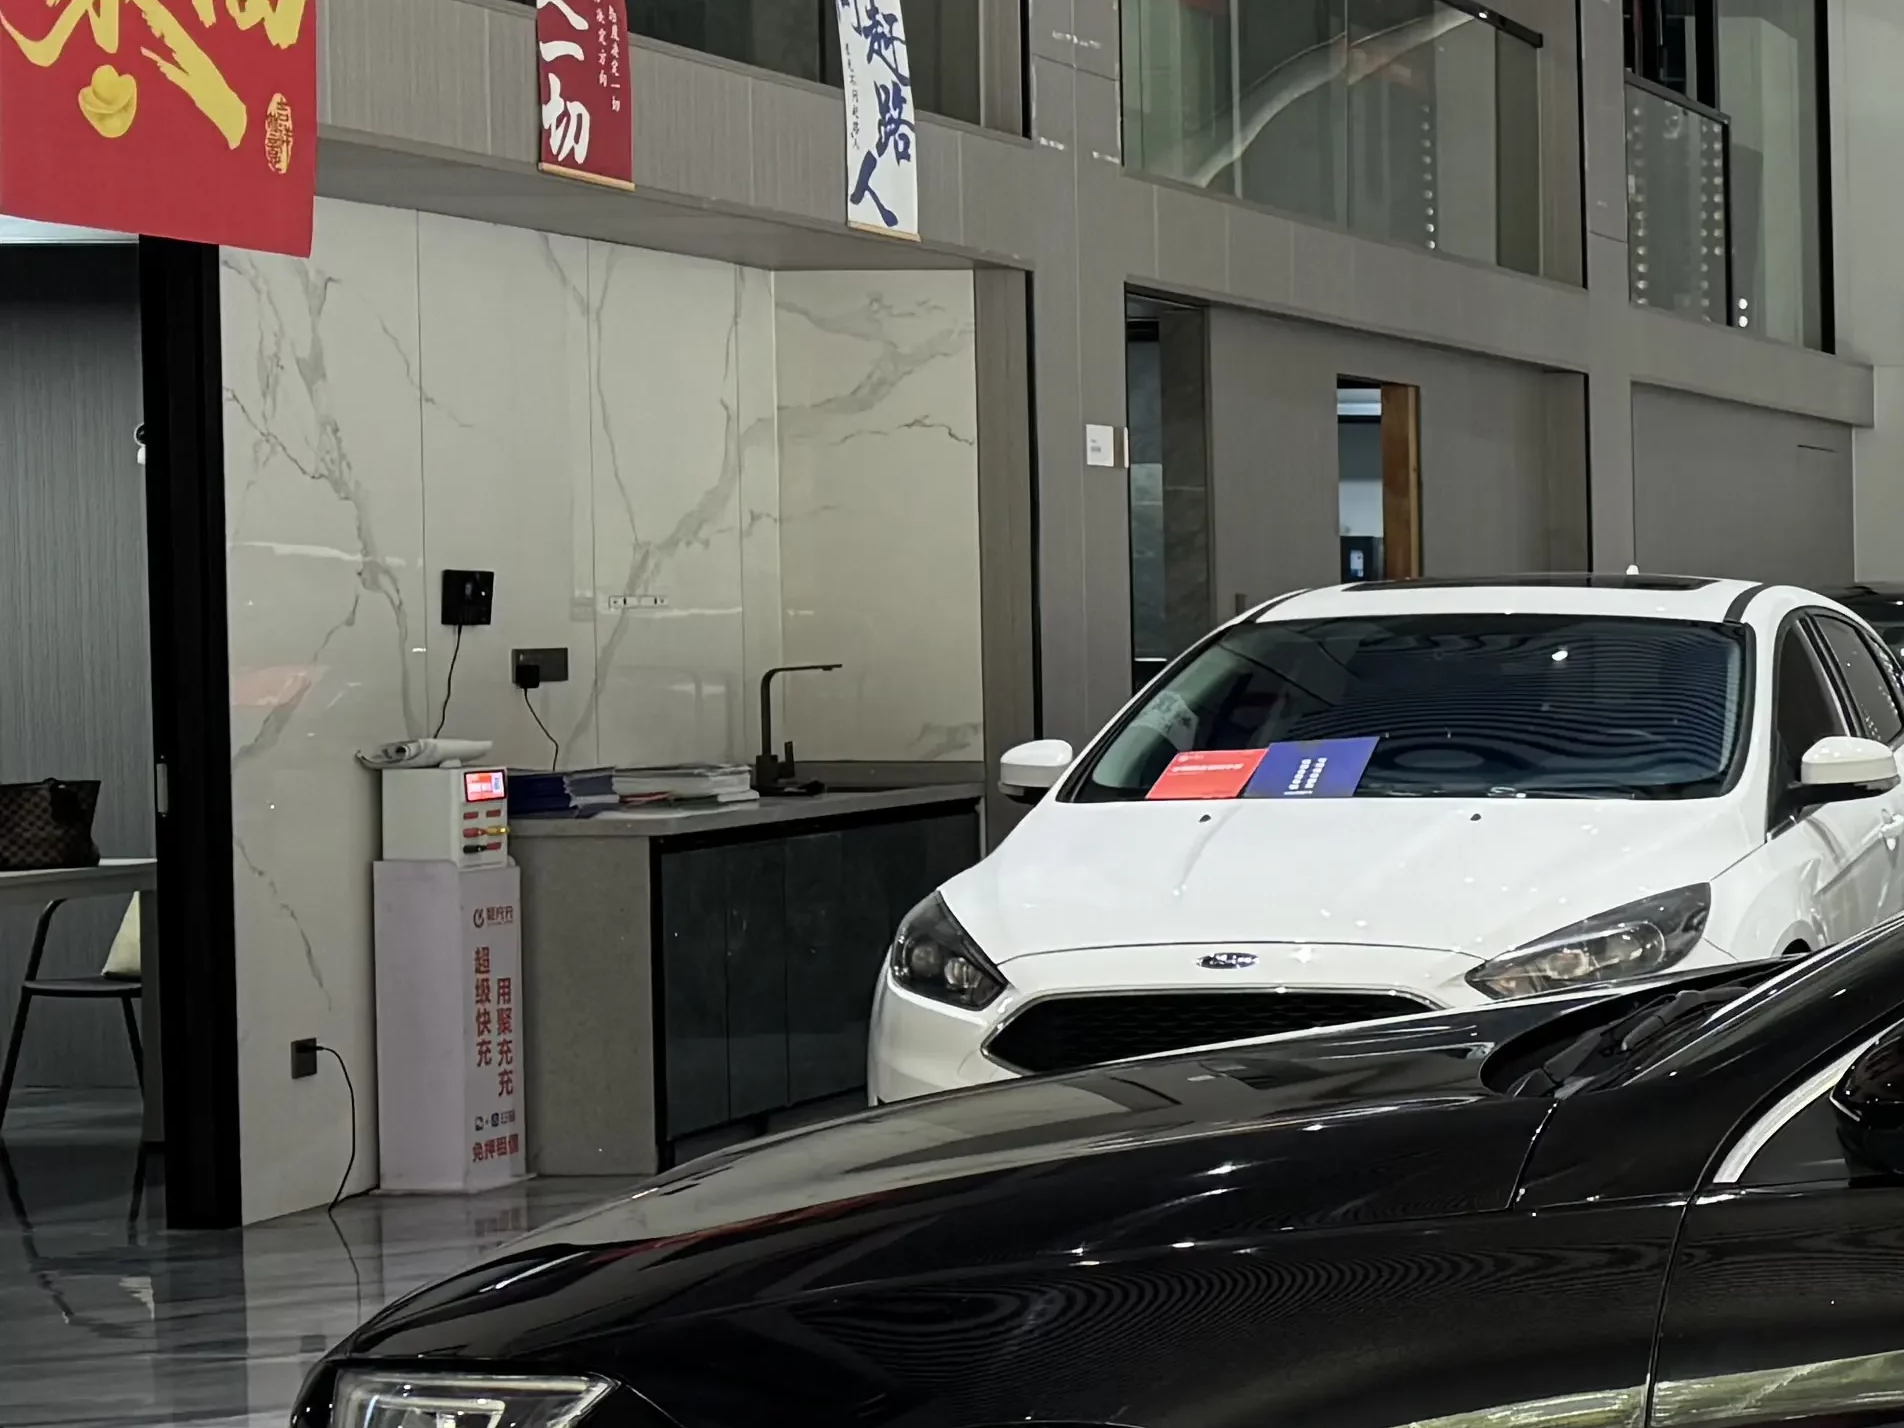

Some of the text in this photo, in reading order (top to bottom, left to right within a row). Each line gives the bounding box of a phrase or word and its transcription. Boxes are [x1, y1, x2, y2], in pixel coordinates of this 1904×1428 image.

[474, 946, 493, 1068] 超级快充
[496, 977, 514, 1098] 用聚充充
